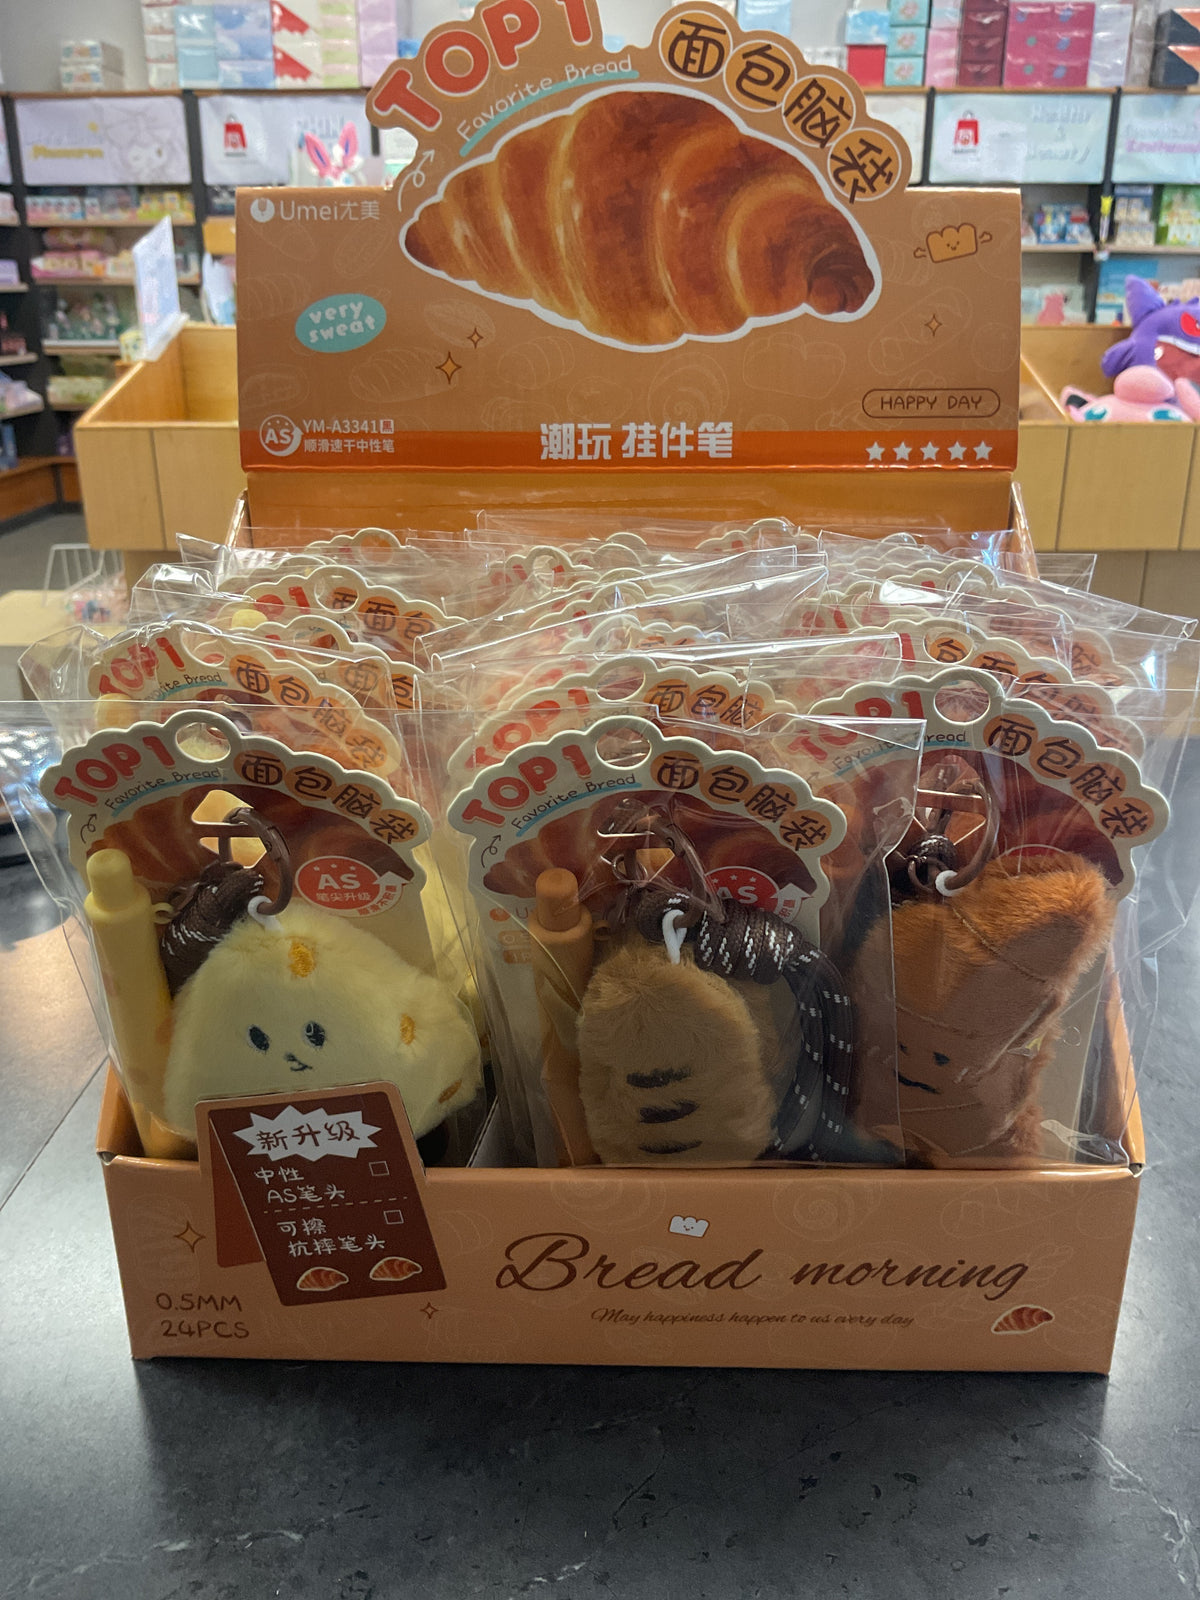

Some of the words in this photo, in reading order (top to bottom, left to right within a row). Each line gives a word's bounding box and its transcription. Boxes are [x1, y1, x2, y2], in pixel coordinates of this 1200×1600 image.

[456, 77, 553, 142] Favorite
[564, 55, 632, 84] Bread
[668, 19, 893, 204] 面包脑袋
[309, 301, 364, 324] very
[309, 314, 375, 343] sweat
[880, 395, 937, 411] HAPPY
[947, 395, 982, 411] DAY
[264, 428, 292, 445] AS
[304, 439, 395, 453] 顺滑速干中性笔
[540, 423, 612, 460] 潮玩
[621, 422, 734, 458] 挂件笔
[183, 672, 222, 685] Bread
[105, 777, 165, 810] Favorite
[172, 767, 221, 783] Bread
[988, 718, 1148, 838] 面包脑袋
[242, 754, 415, 845] 面包脑袋
[511, 789, 577, 830] Favorite
[586, 774, 636, 793] Bread
[657, 756, 827, 851] 面包脑袋
[318, 873, 361, 890] AS
[717, 886, 758, 904] AS
[256, 1120, 361, 1151] 新升级
[255, 1166, 304, 1185] 中性
[267, 1184, 345, 1204] AS笔头
[277, 1217, 327, 1236] 可擦
[288, 1233, 386, 1257] 抗摔笔头
[496, 1232, 765, 1292] Bread
[791, 1257, 1029, 1300] morning
[156, 1293, 243, 1312] 0.5MM
[160, 1320, 250, 1339] 24PCS
[591, 1308, 640, 1325] May
[643, 1310, 725, 1325] happiness
[728, 1311, 787, 1326] happen
[790, 1313, 806, 1324] to
[811, 1315, 830, 1324] us
[834, 1315, 877, 1327] every
[880, 1313, 915, 1328] day
